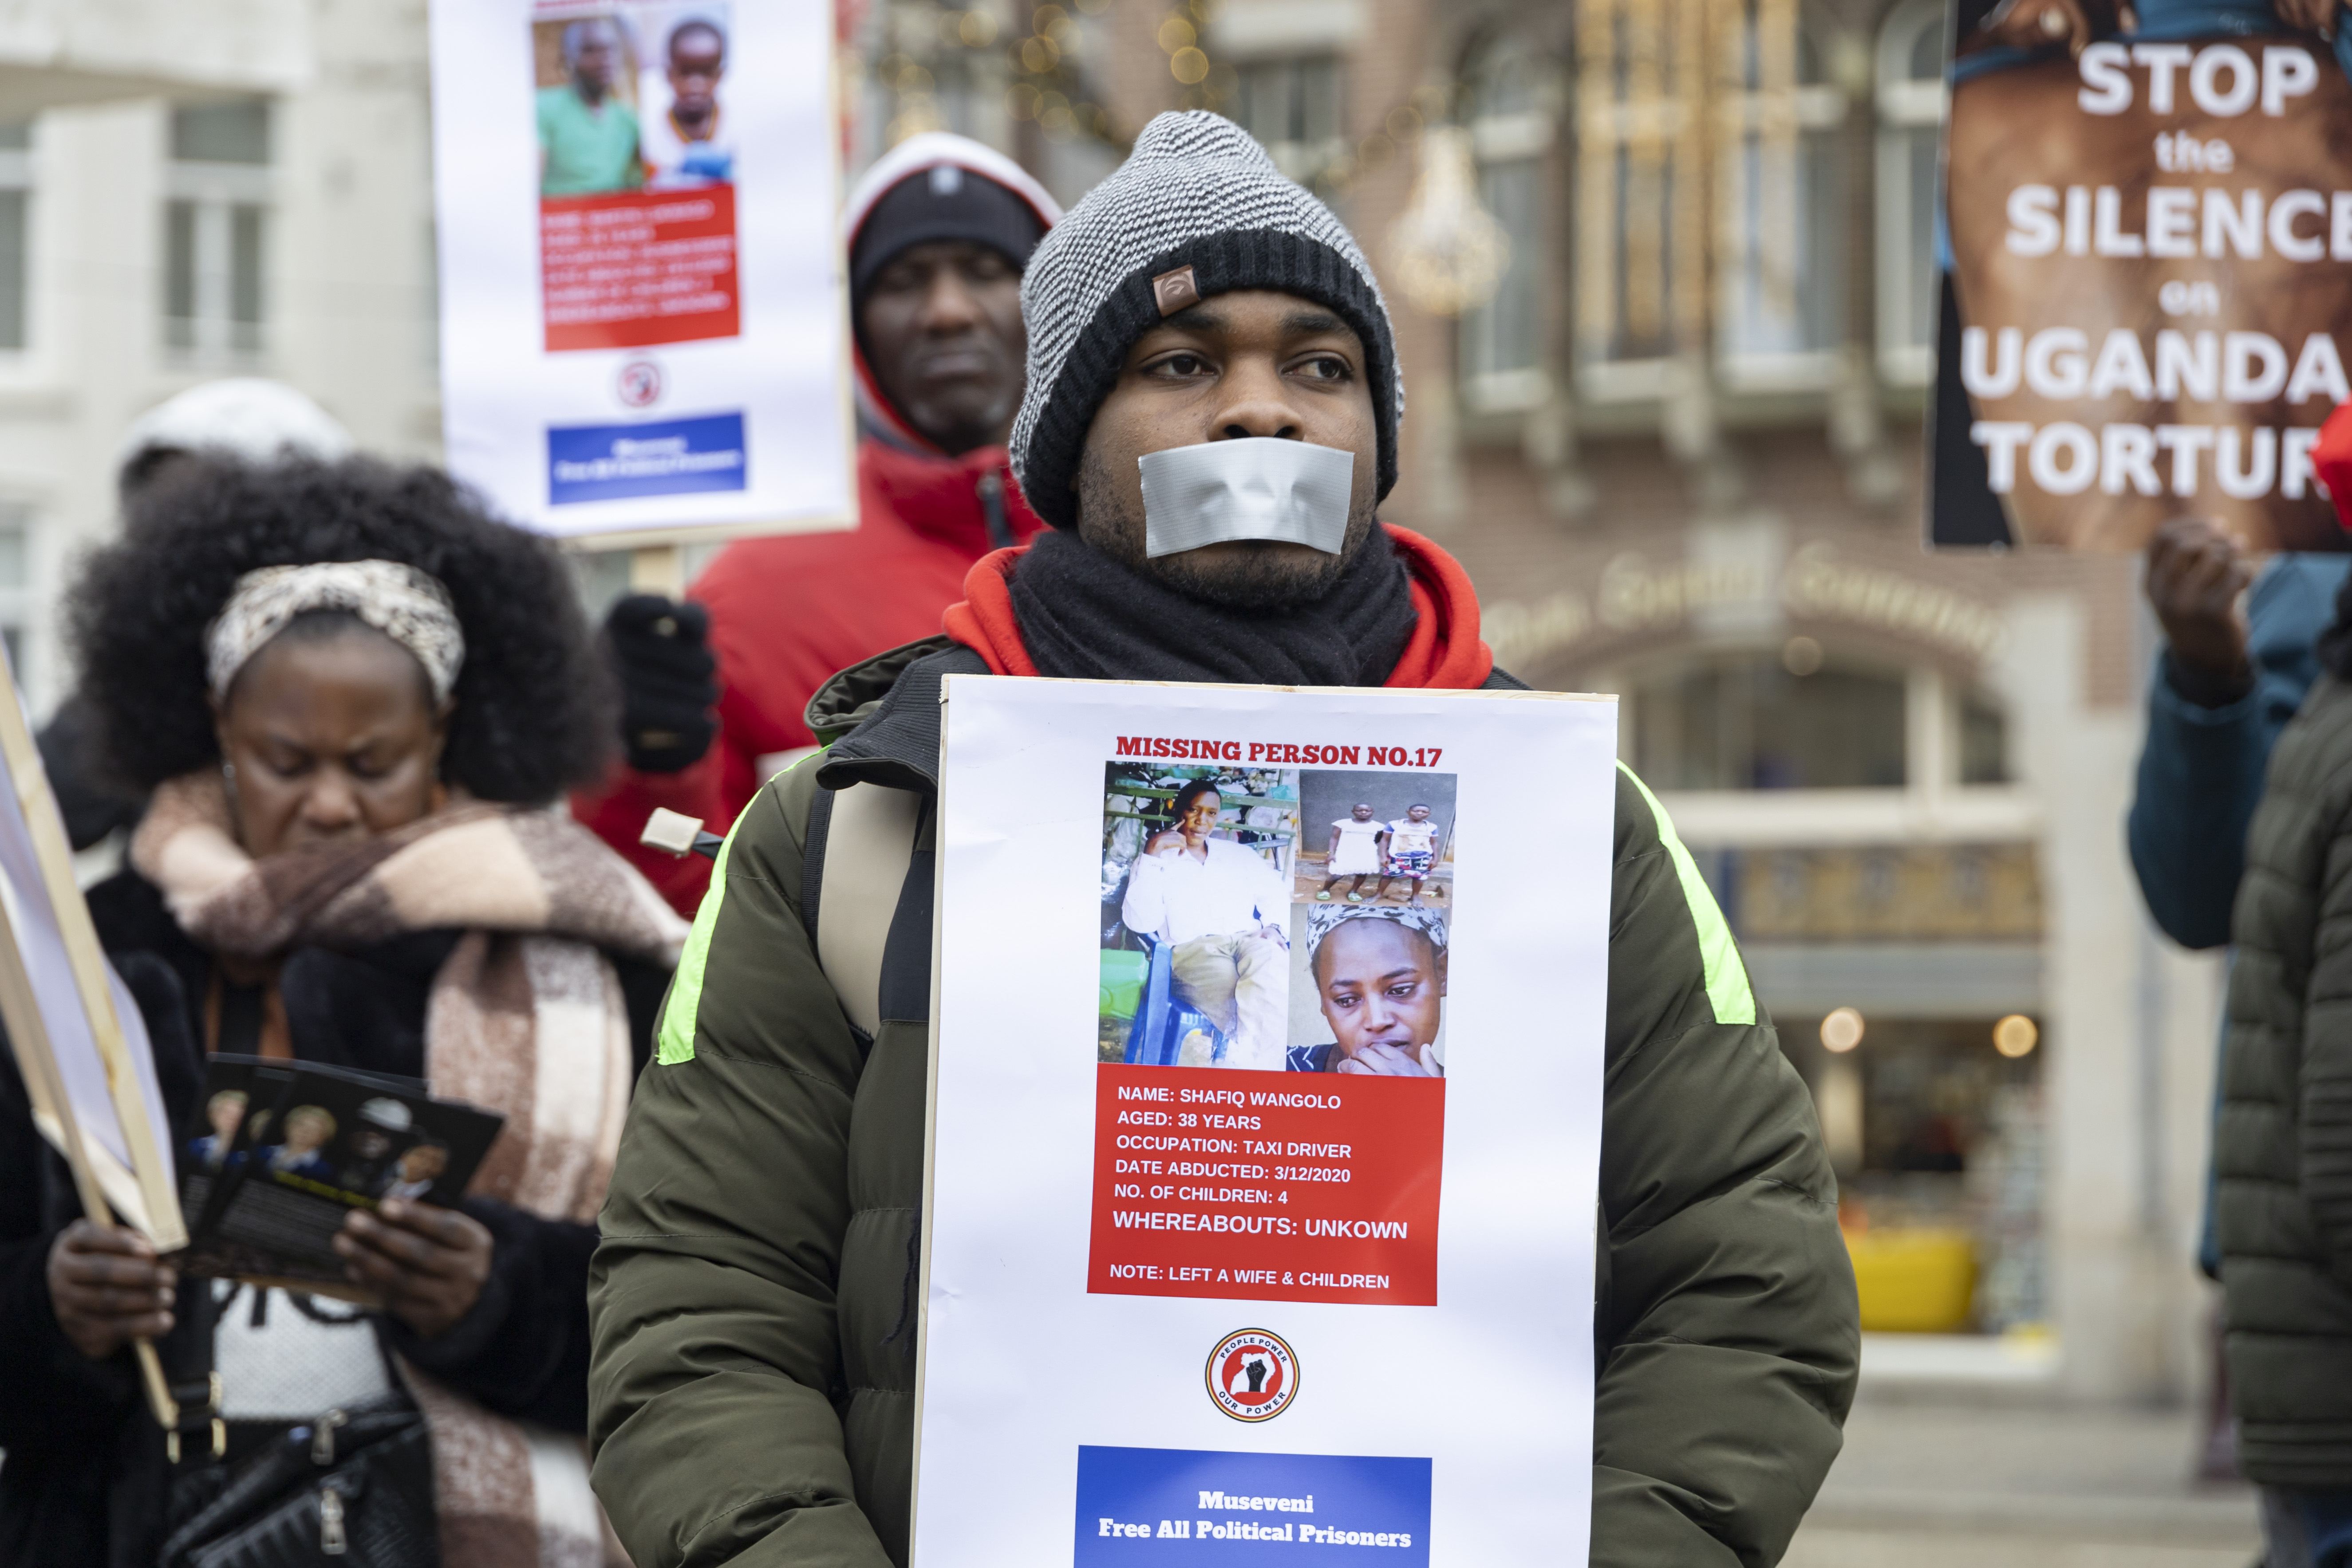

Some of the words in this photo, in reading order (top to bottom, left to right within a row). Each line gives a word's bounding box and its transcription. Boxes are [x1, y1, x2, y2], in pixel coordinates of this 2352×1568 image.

[2078, 43, 2317, 116] STOP
[2155, 130, 2233, 173] the
[2159, 280, 2220, 317] on
[1961, 325, 2350, 404] UGANDA
[1970, 420, 2331, 500] TORTUR
[1117, 737, 1240, 760] MISSING
[1250, 743, 1359, 764] PERSON
[1368, 747, 1441, 766] NO.17
[1119, 1086, 1174, 1101] NAME:
[1180, 1089, 1244, 1108] SHAFIQ
[1250, 1092, 1341, 1109] WANGOLO
[1117, 1111, 1172, 1126] AGED:
[1178, 1114, 1197, 1127] 38
[1203, 1114, 1261, 1130] YEARS
[1117, 1135, 1237, 1153] OCCUPATION:
[1243, 1141, 1281, 1155] TAXI
[1287, 1143, 1351, 1158] DRIVER
[1116, 1160, 1162, 1174] DATE
[1168, 1162, 1268, 1179] ABDUCTED:
[1275, 1166, 1350, 1182] 3/12/2020
[1115, 1184, 1144, 1197] NO.
[1150, 1185, 1174, 1199] OF
[1179, 1187, 1272, 1203] CHILDREN:
[1278, 1191, 1288, 1204] 4
[1113, 1211, 1297, 1235] WHEREABOUTS:
[1306, 1219, 1407, 1238] UNKOWN
[1110, 1264, 1163, 1279] NOTE:
[1169, 1267, 1212, 1281] LEFT
[1217, 1269, 1228, 1282] A
[1234, 1270, 1276, 1284] WIFE
[1282, 1272, 1294, 1284] &
[1299, 1272, 1389, 1288] CHILDREN
[1219, 1337, 1255, 1359] PEOPLE
[1259, 1339, 1287, 1363] POWER
[1219, 1391, 1238, 1410] OUR
[1246, 1391, 1286, 1414] POWER
[1199, 1491, 1314, 1513] Museveni
[1099, 1518, 1151, 1537] Free
[1157, 1521, 1190, 1538] All
[1196, 1521, 1293, 1541] Political
[1299, 1525, 1411, 1547] Prisoners
